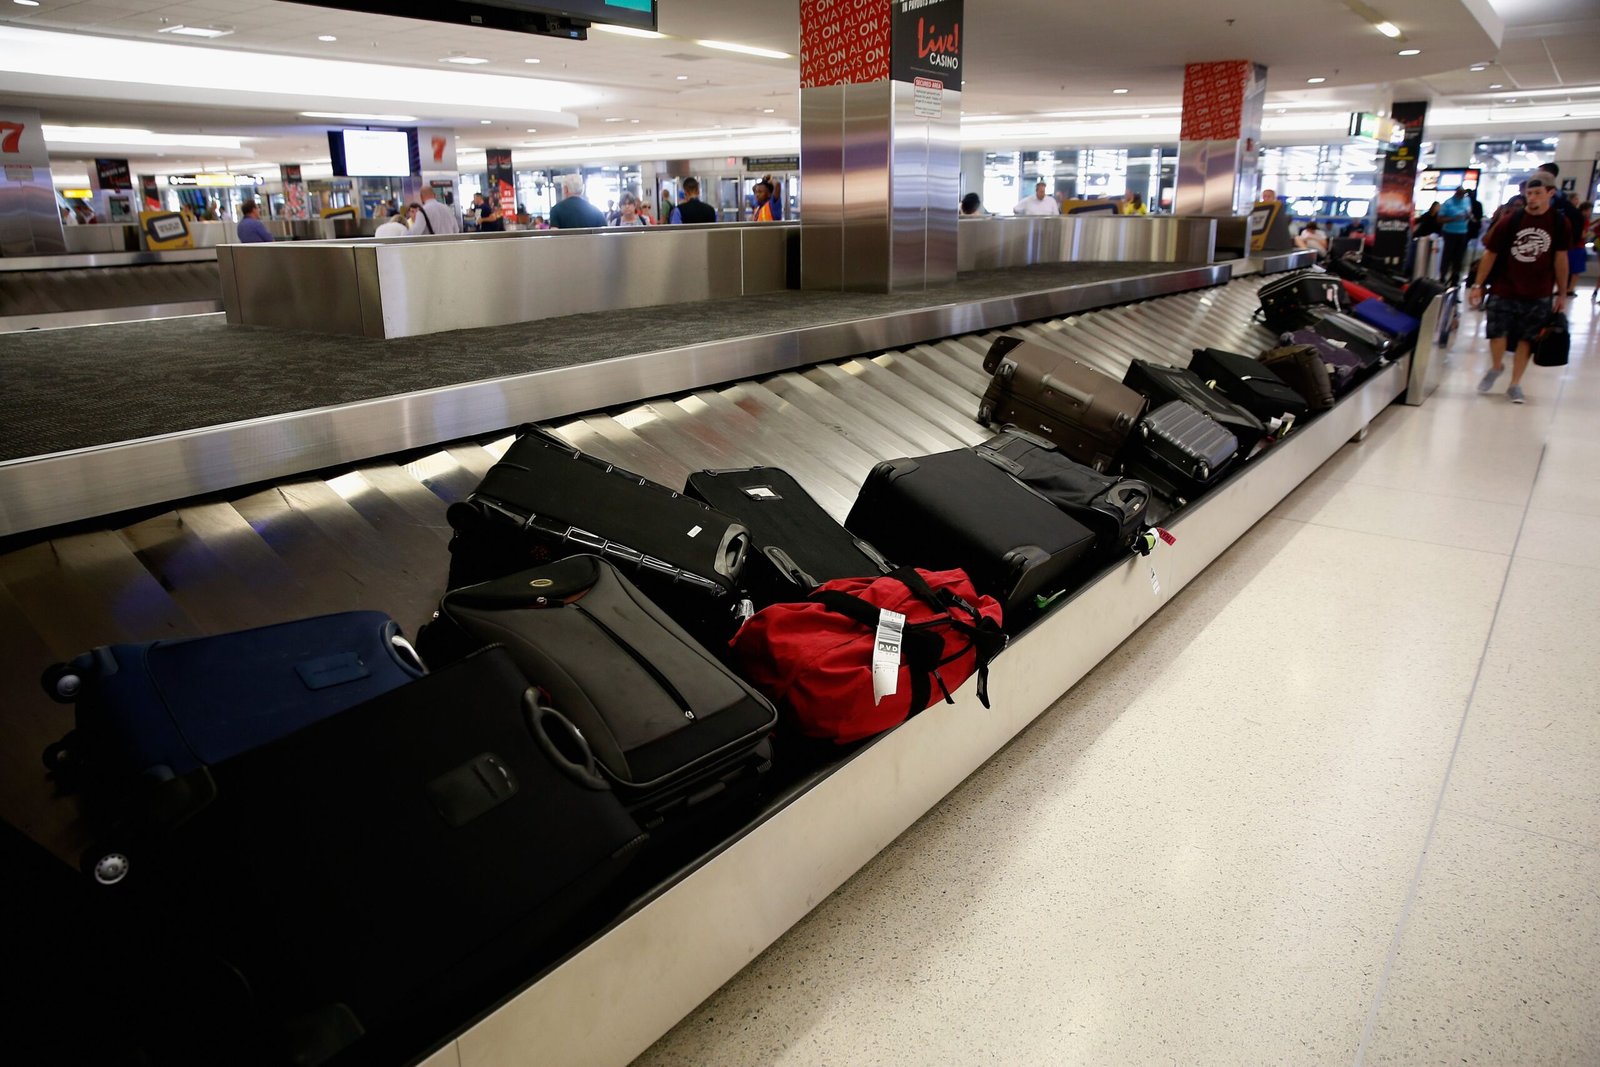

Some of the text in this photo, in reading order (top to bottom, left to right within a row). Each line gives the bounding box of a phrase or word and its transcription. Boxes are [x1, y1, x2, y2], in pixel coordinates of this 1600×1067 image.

[807, 2, 851, 33] ALWAYS
[822, 22, 840, 39] ON
[812, 29, 857, 59] ALWAYS
[860, 18, 878, 36] ON
[918, 16, 959, 59] Live!
[818, 55, 863, 85] ALWAYS
[865, 45, 884, 63] ON
[828, 48, 846, 65] ON
[929, 52, 959, 69] CASINO
[0, 121, 25, 153] 7
[431, 135, 447, 162] 7
[879, 643, 899, 653] PVD
